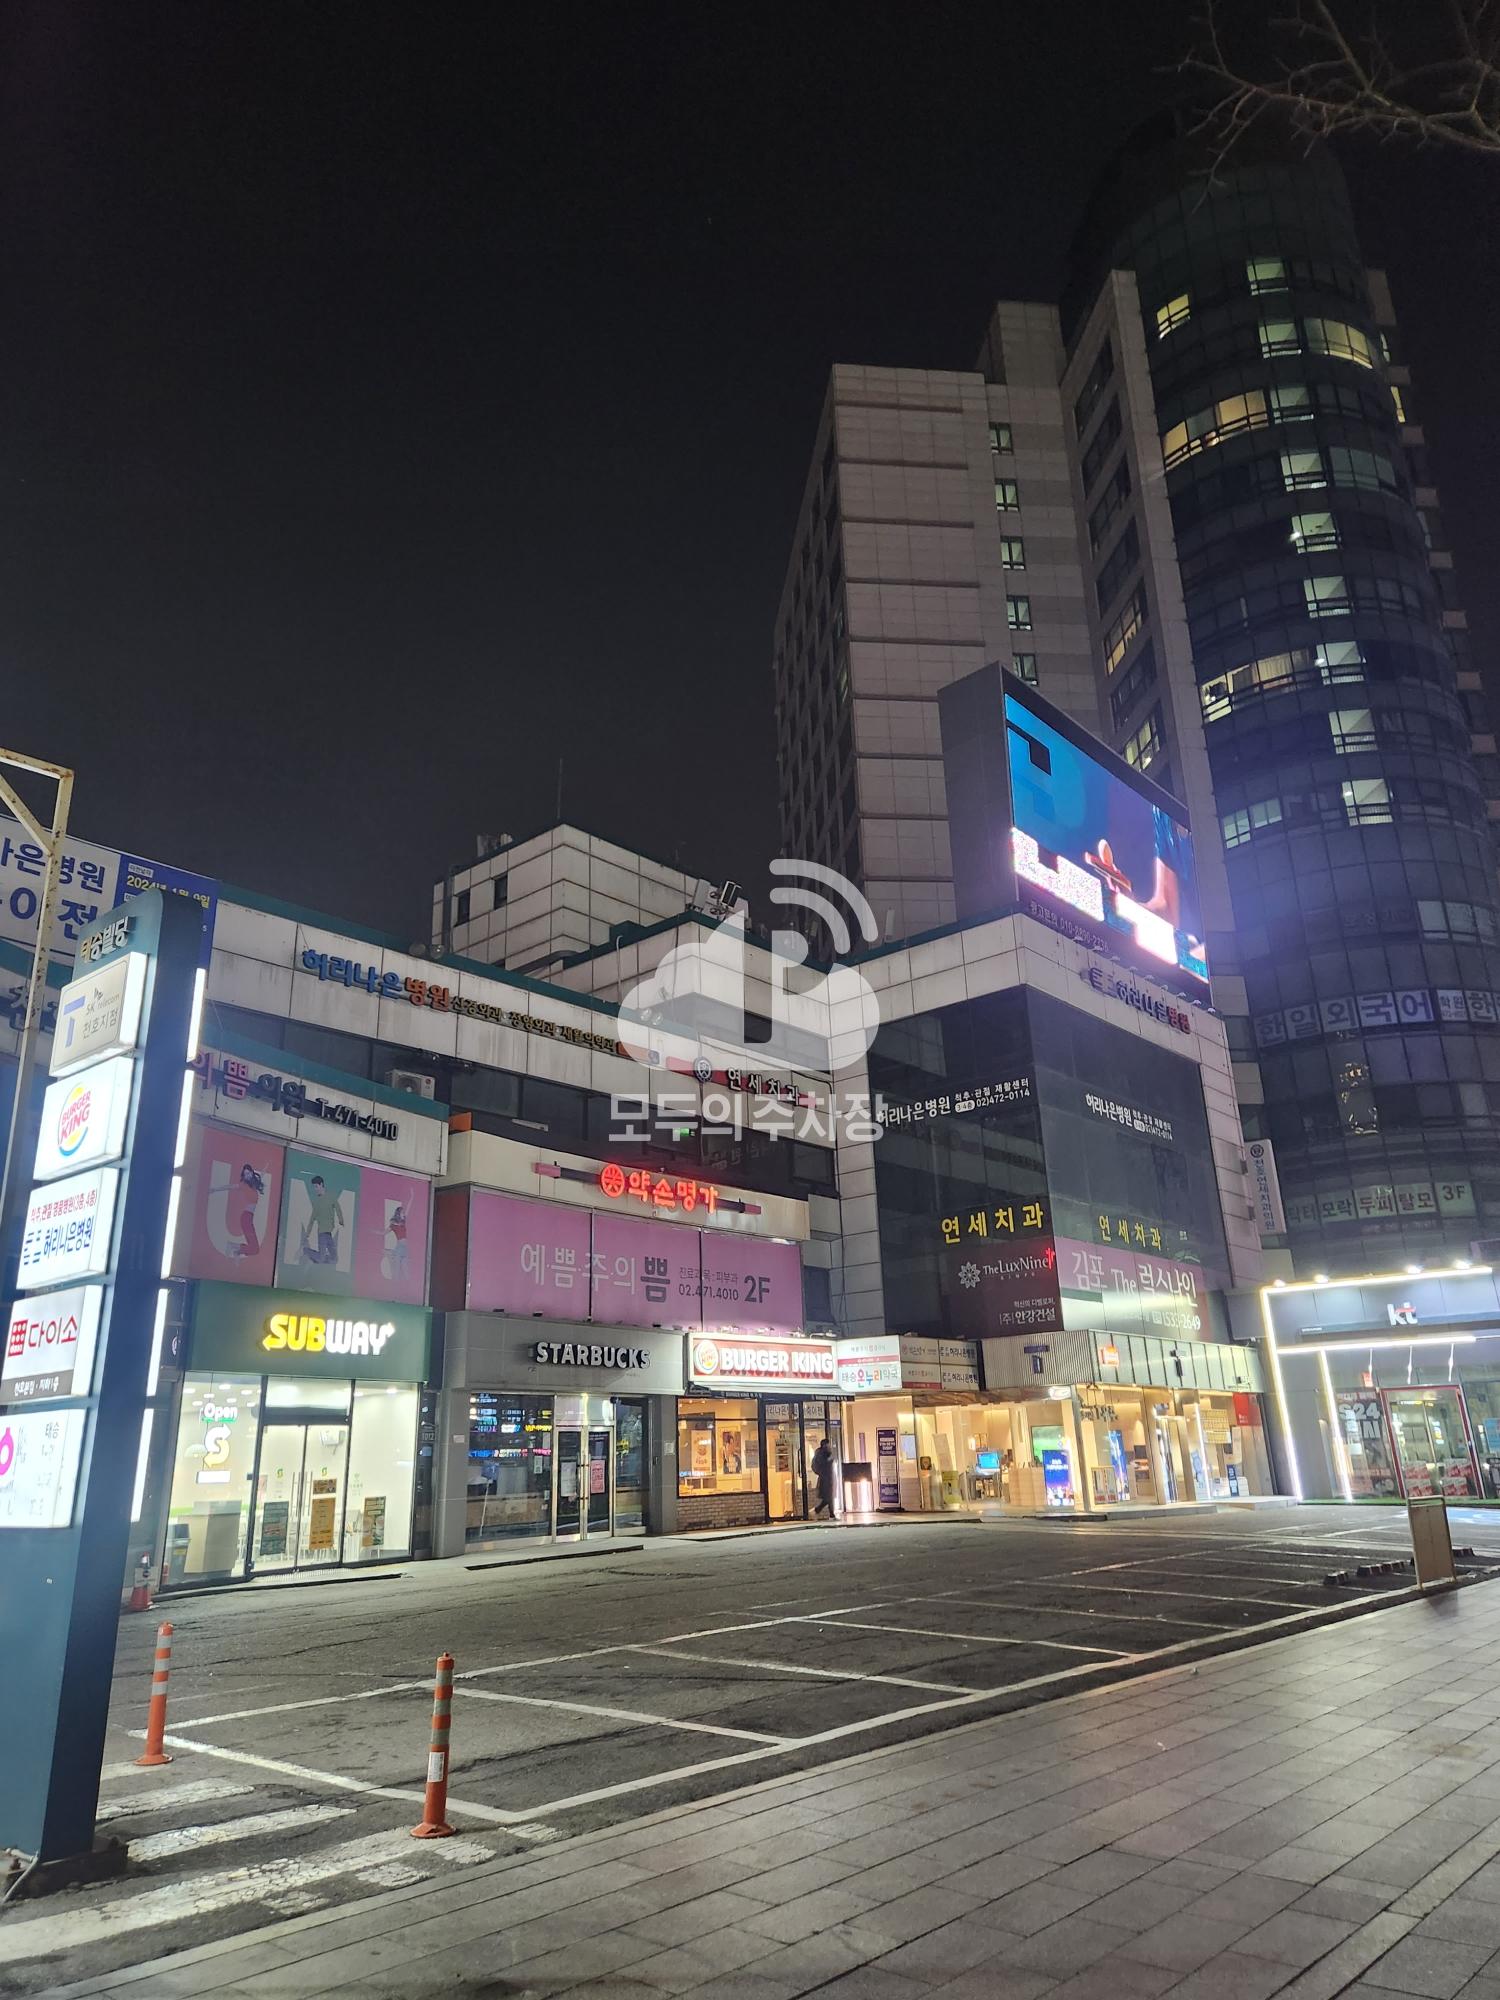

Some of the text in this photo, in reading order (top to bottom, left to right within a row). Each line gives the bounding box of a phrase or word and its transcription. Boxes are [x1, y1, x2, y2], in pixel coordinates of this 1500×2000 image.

[303, 949, 449, 1012] 허리나은병원
[451, 996, 501, 1021] 신경외과
[511, 1011, 556, 1037] 정형외과
[727, 1066, 800, 1106] 연세치과
[60, 1103, 91, 1144] KING
[62, 1091, 91, 1126] BURGER
[629, 1171, 718, 1215] 약손명가
[1442, 1185, 1465, 1200] 3F
[942, 1203, 1043, 1244] 연세치과
[1100, 1216, 1162, 1250] 연세치과
[744, 1275, 771, 1303] 2F
[1072, 1250, 1108, 1290] 김포
[1111, 1268, 1137, 1297] The
[28, 1315, 78, 1348] 다이소
[263, 1313, 395, 1356] SUBWAY
[536, 1341, 651, 1369] STARBUCKS
[720, 1348, 790, 1373] BURGER
[791, 1351, 834, 1374] KING
[203, 1402, 238, 1422] Open
